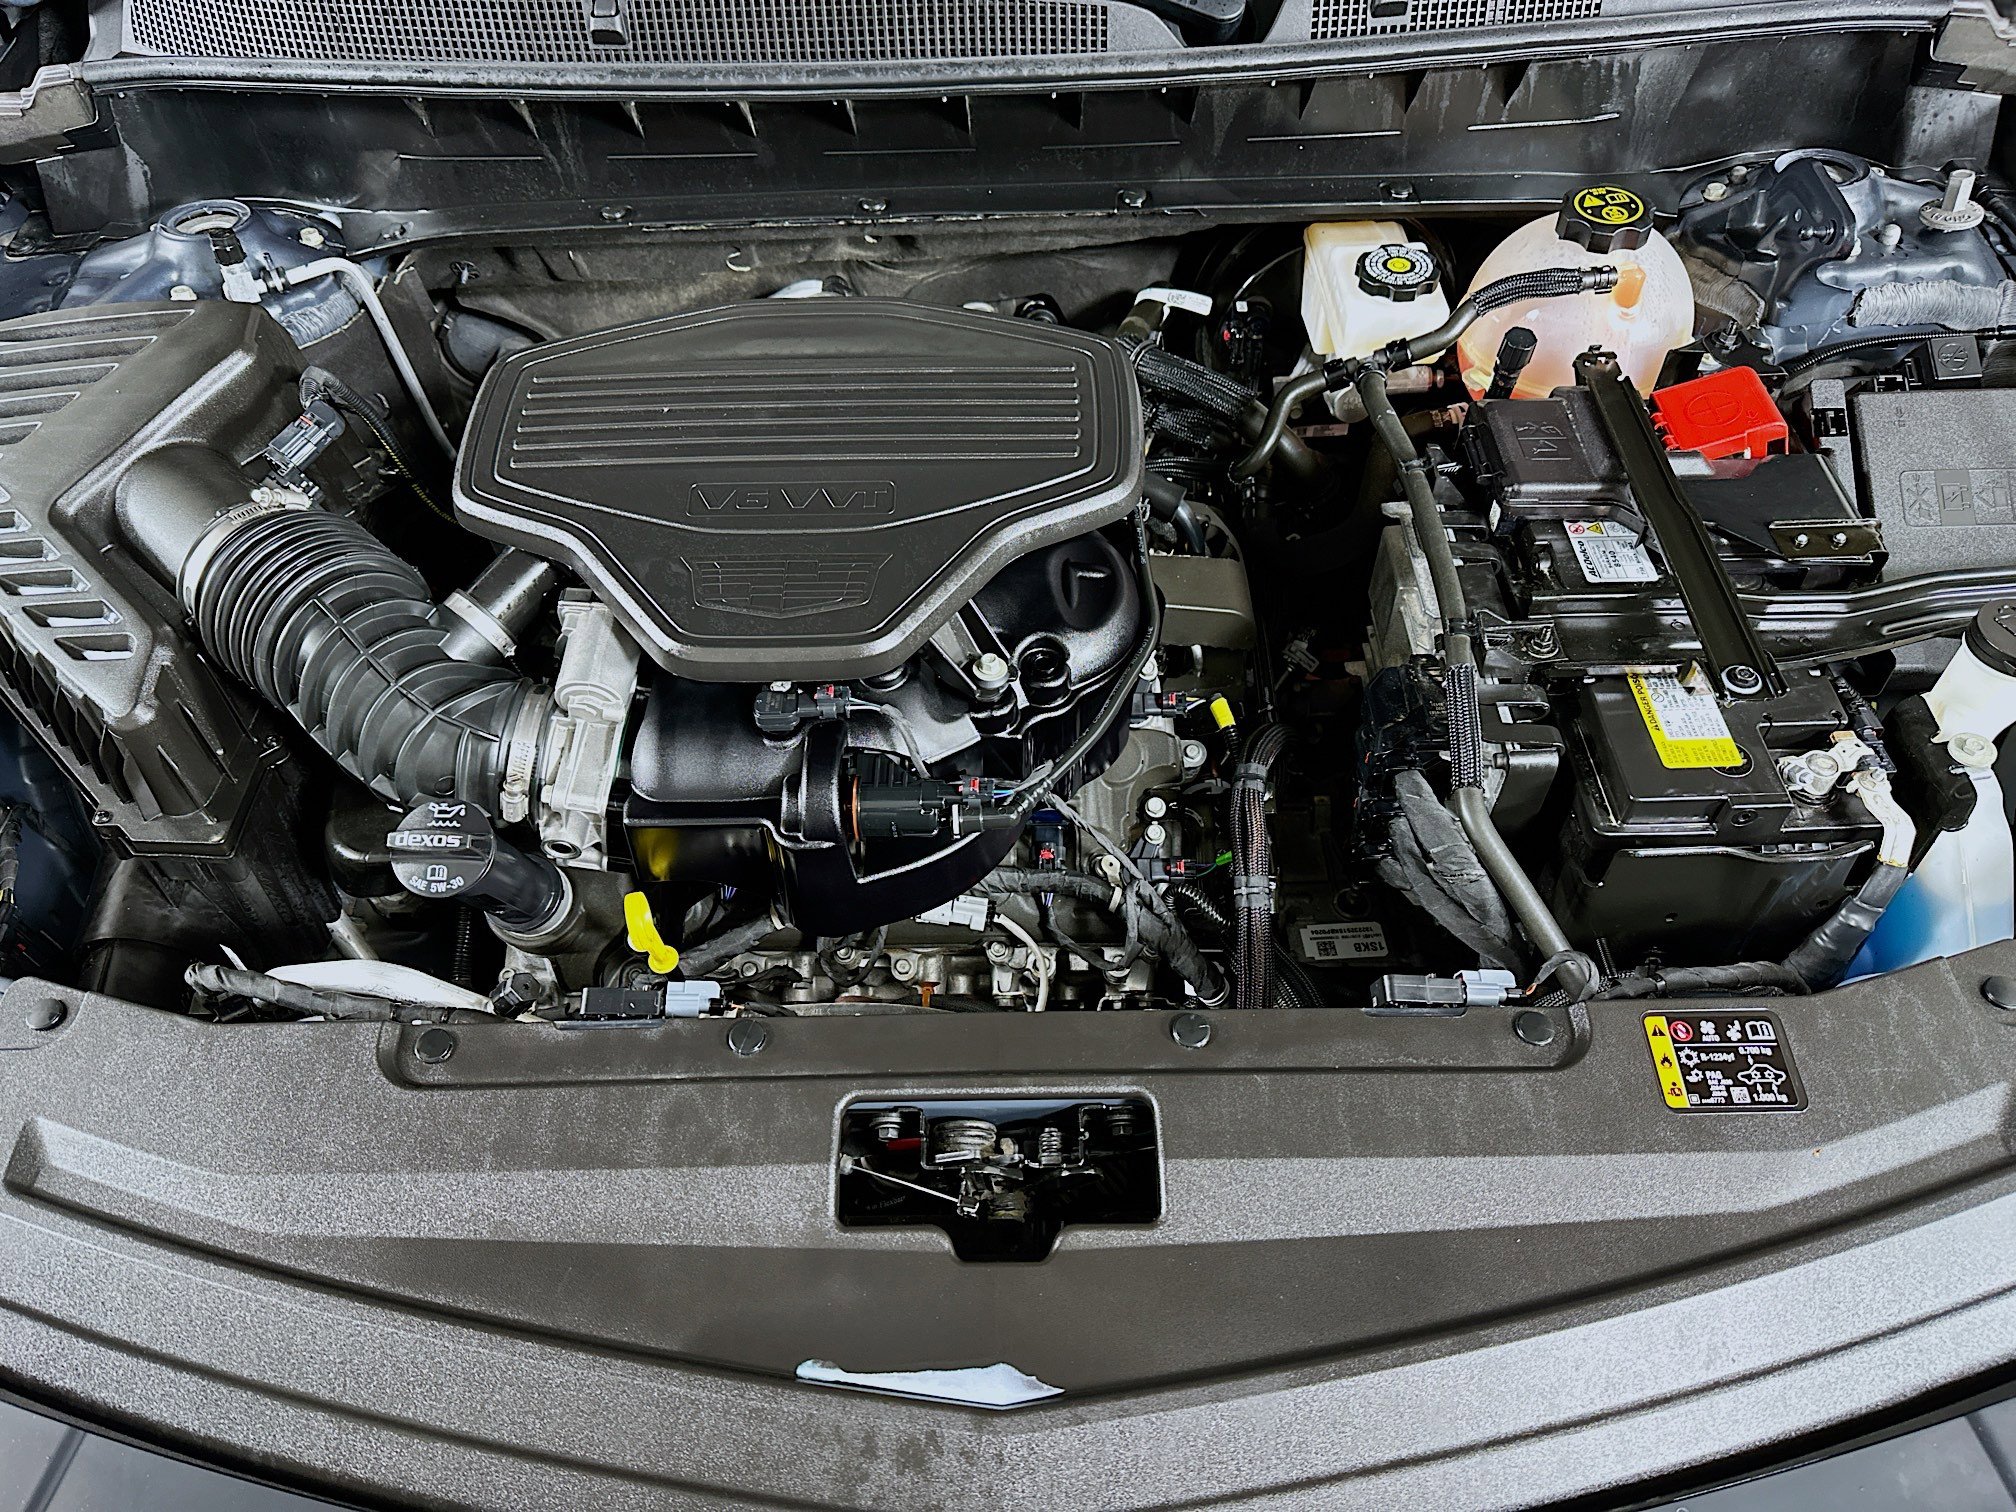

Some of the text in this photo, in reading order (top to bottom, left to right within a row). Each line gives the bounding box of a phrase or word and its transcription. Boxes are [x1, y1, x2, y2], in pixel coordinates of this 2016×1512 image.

[697, 487, 888, 510] V6 VVT
[1577, 540, 1598, 578] ACDelco
[1640, 696, 1659, 726] DANGER
[394, 832, 463, 847] dexos
[409, 875, 465, 893] SAE 5W-30
[1353, 941, 1385, 953] 1SKB
[1700, 1053, 1736, 1062] R-1234yf
[1705, 1071, 1723, 1080] PAG
